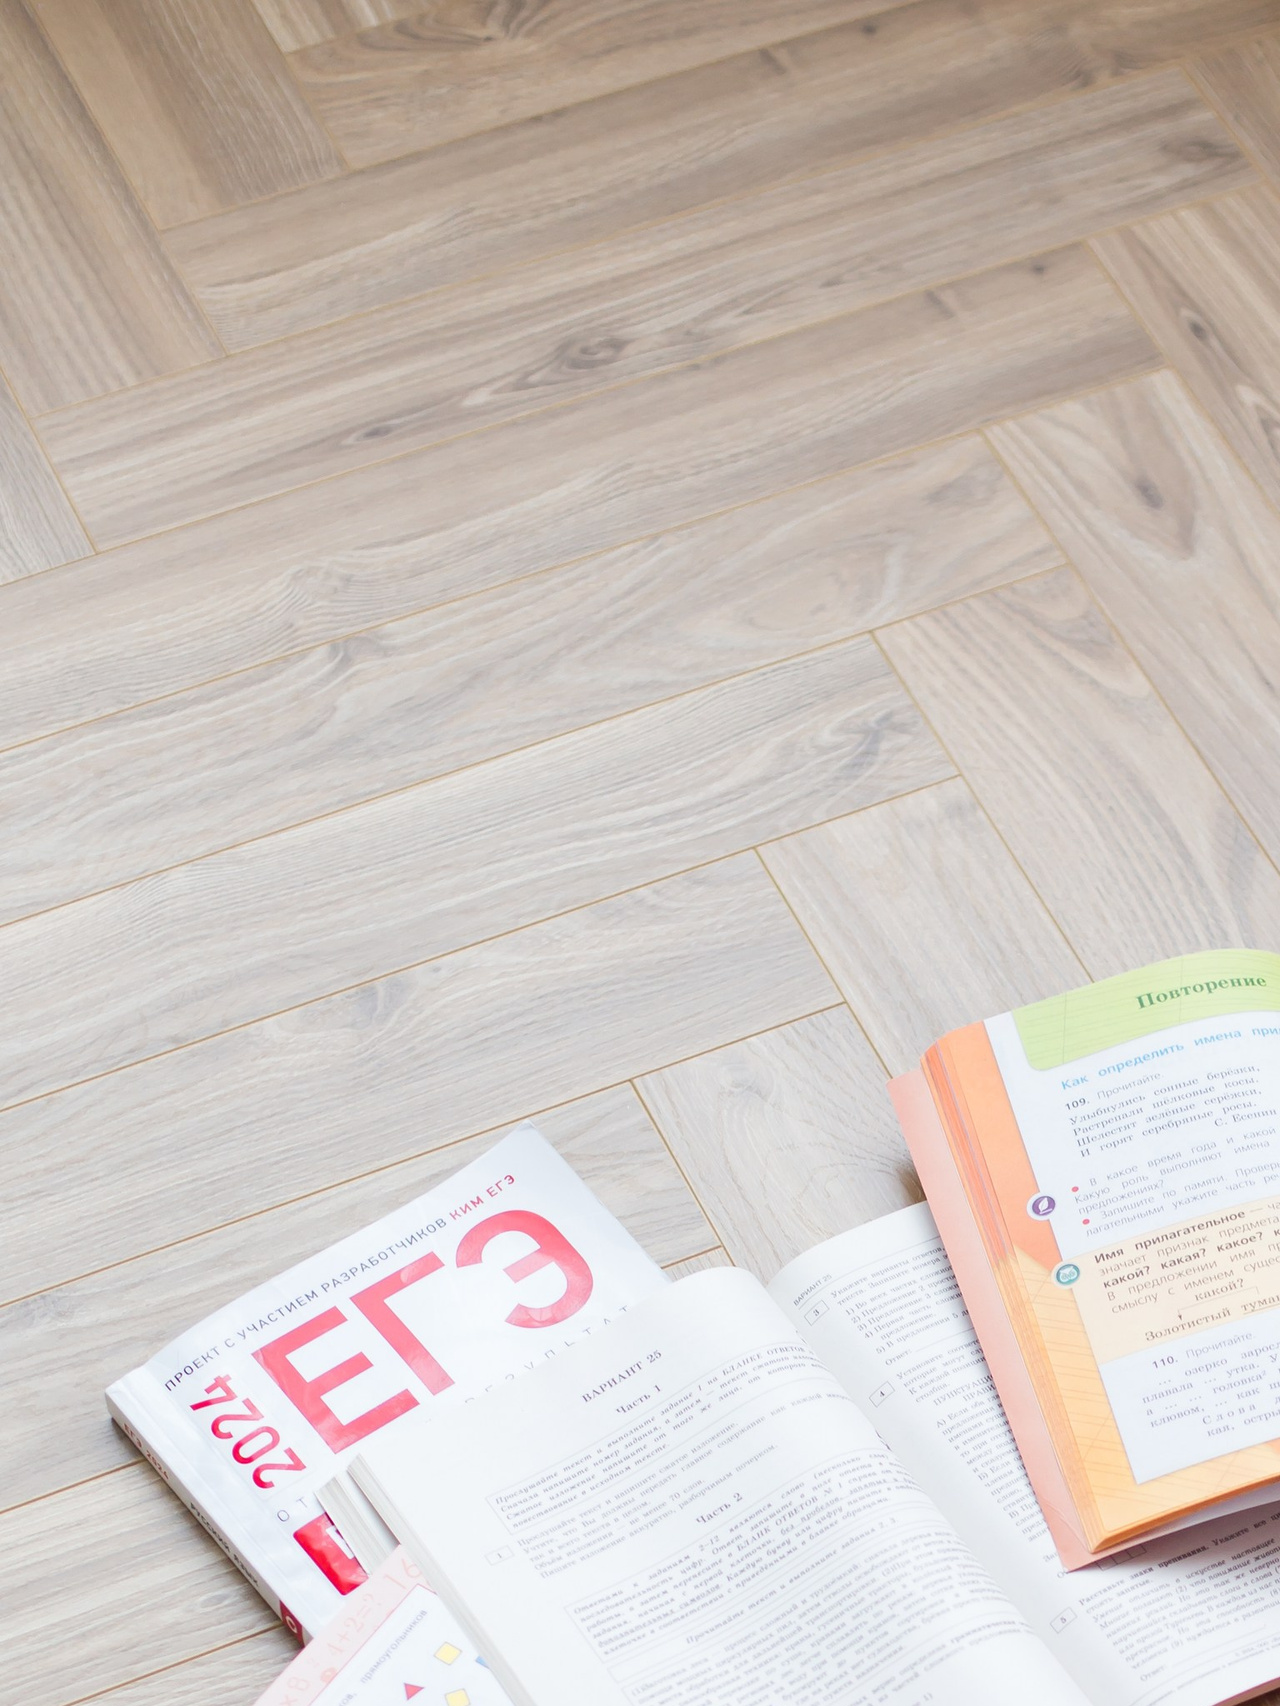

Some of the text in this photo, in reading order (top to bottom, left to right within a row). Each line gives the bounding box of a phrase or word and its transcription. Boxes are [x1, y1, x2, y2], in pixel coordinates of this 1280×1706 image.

[1136, 977, 1266, 1009] Повторение
[1060, 1029, 1242, 1090] Как определить имена
[1065, 1072, 1164, 1110] 109. Прочитайте.
[1093, 1248, 1124, 1264] Имя
[1134, 1210, 1245, 1250] прилагательное
[1102, 1264, 1150, 1288] какой?
[1160, 1247, 1206, 1270] какая?
[1216, 1230, 1262, 1252] какое?
[164, 1173, 515, 1392] ПРОЕКТ С УЧАСТИЕМ РАЗРАБОТЧИКОВ КИМ ЕГЭ
[792, 1273, 834, 1306] ВАРИАНТ 25
[1194, 1277, 1243, 1301] какой?
[251, 1208, 595, 1454] ЕГЭ
[1144, 1306, 1231, 1341] Золотистый
[1152, 1332, 1256, 1368] 110. Прочитайте.
[581, 1349, 662, 1402] ВАРИАНТ 25
[615, 1384, 661, 1413] Часть 1
[189, 1373, 307, 1489] 2024
[695, 1492, 743, 1523] Часть 2
